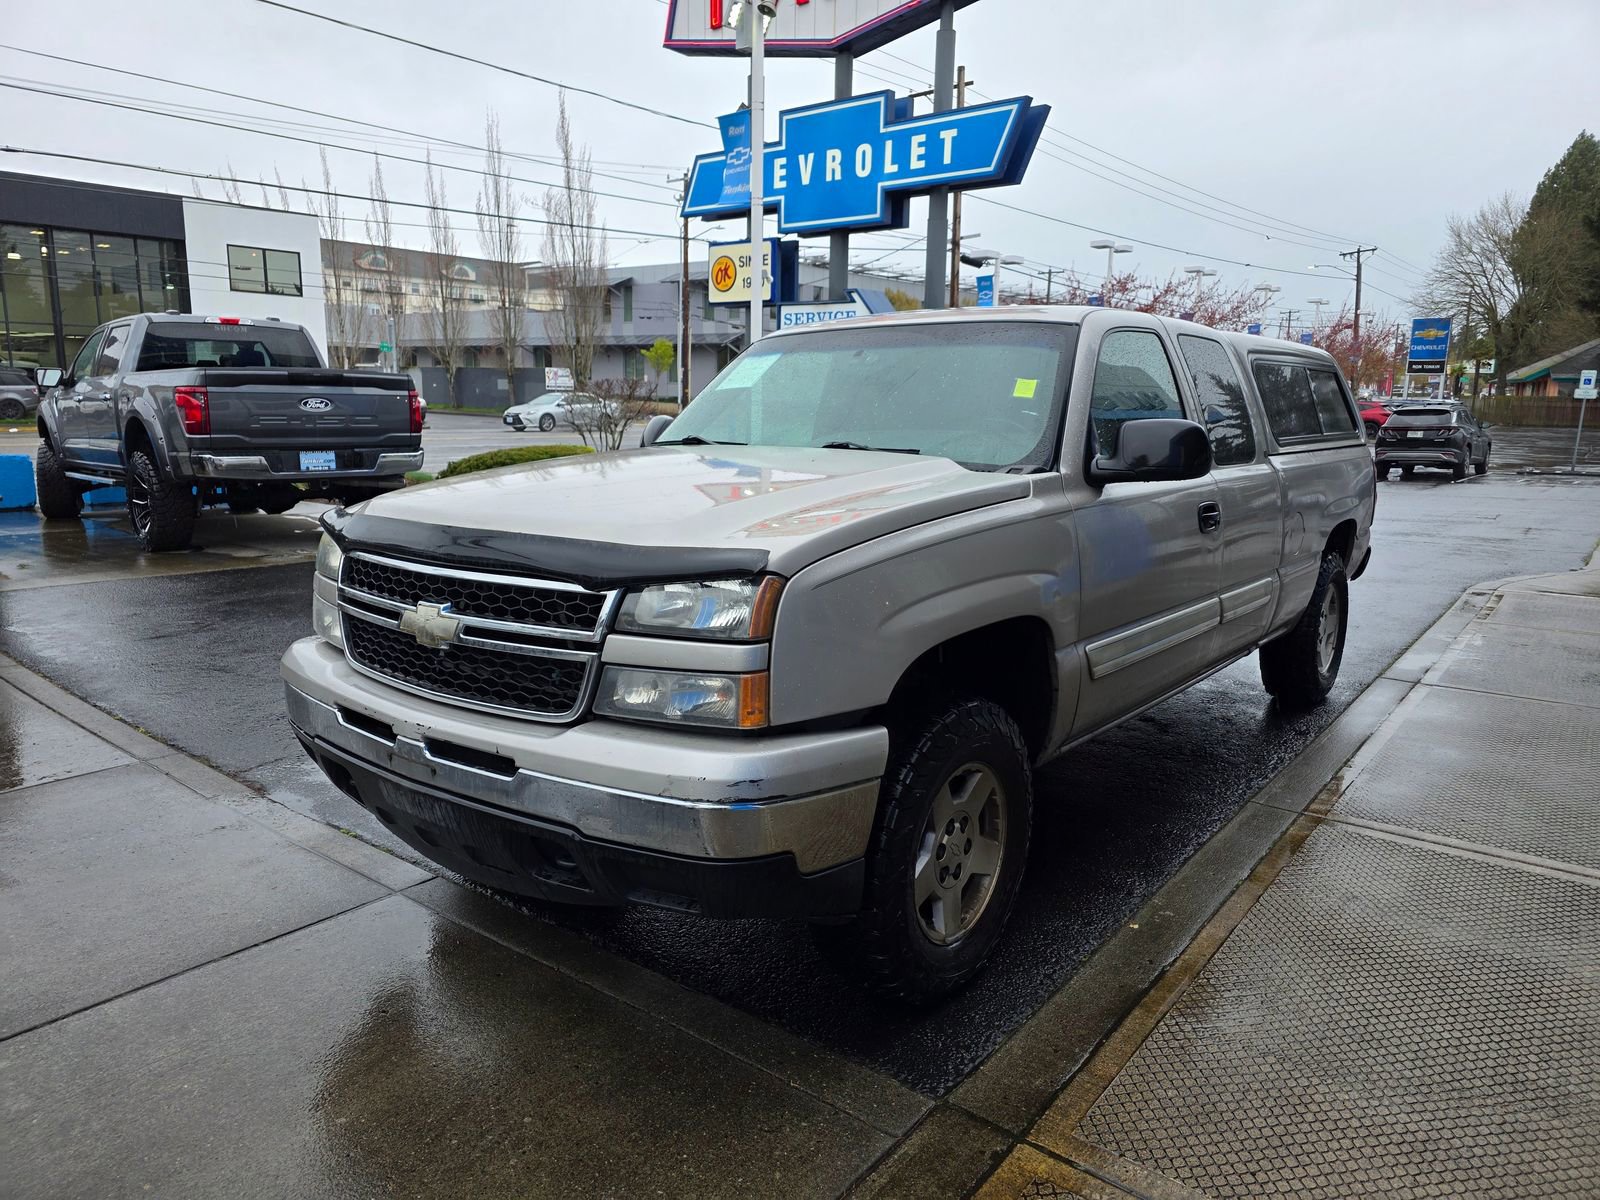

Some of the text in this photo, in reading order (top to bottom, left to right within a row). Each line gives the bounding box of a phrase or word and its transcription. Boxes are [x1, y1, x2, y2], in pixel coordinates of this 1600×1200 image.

[722, 128, 958, 193] EVROLET
[738, 254, 769, 268] SIE
[306, 400, 326, 409] Ford
